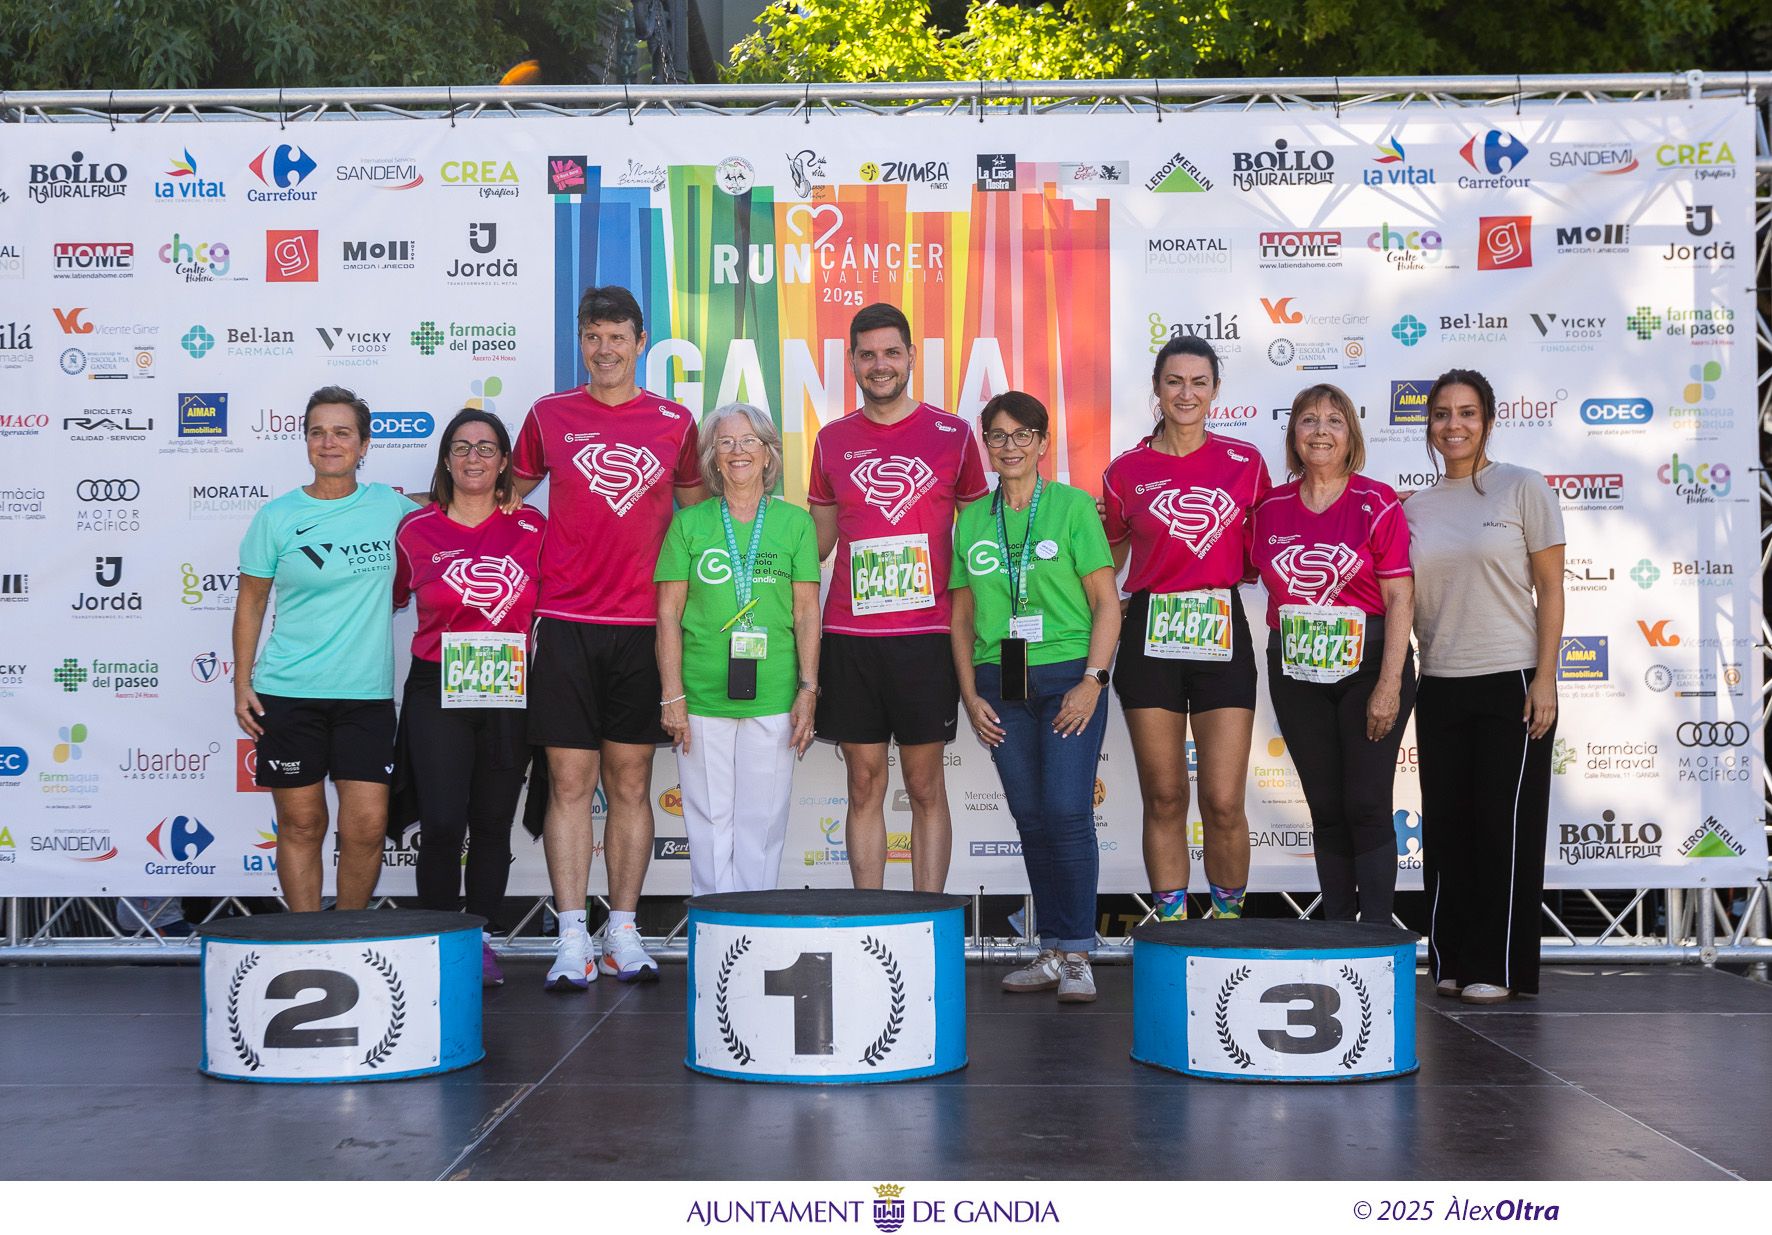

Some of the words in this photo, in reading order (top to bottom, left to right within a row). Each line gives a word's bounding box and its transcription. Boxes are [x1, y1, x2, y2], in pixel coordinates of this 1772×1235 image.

[1233, 138, 1334, 171] BOLLO
[1550, 149, 1633, 168] SANDEMI
[1656, 142, 1737, 167] CREA
[29, 151, 128, 184] BOLLO
[337, 165, 417, 181] SANDEMI
[440, 161, 519, 183] CREA
[881, 161, 949, 183] ZUMBA
[978, 166, 990, 179] La
[1145, 158, 1176, 192] LEROY
[1172, 151, 1214, 192] MERLIN
[1363, 169, 1384, 185] la
[1388, 165, 1436, 185] vital
[155, 182, 174, 198] la
[178, 178, 226, 198] vital
[930, 182, 948, 190] FITNESS
[1458, 175, 1531, 190] Carrefour
[247, 188, 318, 202] Carrefour
[1556, 224, 1624, 246] Moll
[343, 240, 408, 261] Moll
[1149, 238, 1227, 251] MORATAL
[1262, 234, 1339, 257] HOME
[56, 244, 132, 268] HOME
[159, 233, 230, 277] chcg
[713, 243, 811, 285] RUN
[819, 236, 944, 270] CÁNCER
[1149, 252, 1227, 264] PALOMINO
[821, 269, 944, 284] VALENCIA
[823, 287, 864, 306] 2025
[1304, 313, 1340, 325] Vicente
[1342, 313, 1370, 325] Giner
[1667, 306, 1735, 321] farmacia
[95, 324, 131, 335] Vicente
[450, 321, 516, 337] farmacia
[1561, 317, 1607, 329] VICKY
[1667, 323, 1685, 336] del
[1690, 323, 1735, 338] paseo
[347, 332, 391, 344] VICKY
[1566, 330, 1603, 338] FOODS
[351, 344, 387, 353] FOODS
[449, 339, 467, 351] del
[472, 340, 516, 355] paseo
[646, 338, 1012, 432] GANIA
[1586, 403, 1645, 420] ODEC
[370, 418, 427, 433] ODEC
[193, 485, 269, 498] MORATAL
[902, 493, 923, 513] PERSONA
[77, 509, 139, 519] MOTOR
[77, 519, 140, 532] PACÍFICO
[340, 540, 391, 556] VICKY
[348, 553, 391, 566] FOODS
[352, 565, 390, 574] ATHLETICS
[856, 561, 927, 594] 64876
[1154, 611, 1229, 641] 64877
[1285, 633, 1361, 662] 64873
[92, 658, 159, 673] farmacia
[449, 660, 524, 688] 64825
[93, 676, 110, 688] del
[115, 677, 159, 691] paseo
[1587, 741, 1658, 755] farmàcia
[1587, 757, 1612, 770] del
[1615, 757, 1655, 770] raval
[1679, 756, 1750, 768] MOTOR
[1679, 767, 1750, 782] PACÍFICO
[965, 803, 999, 811] VALDISA
[1559, 809, 1662, 845] BOLLO
[1677, 823, 1707, 856] LEROY
[1705, 815, 1746, 856] MERLIN
[31, 836, 110, 852] SANDEMI
[145, 862, 216, 875] Carrefour
[243, 854, 262, 871] la
[263, 968, 361, 1050] 2
[764, 951, 835, 1056] 1
[1258, 983, 1344, 1055] 3
